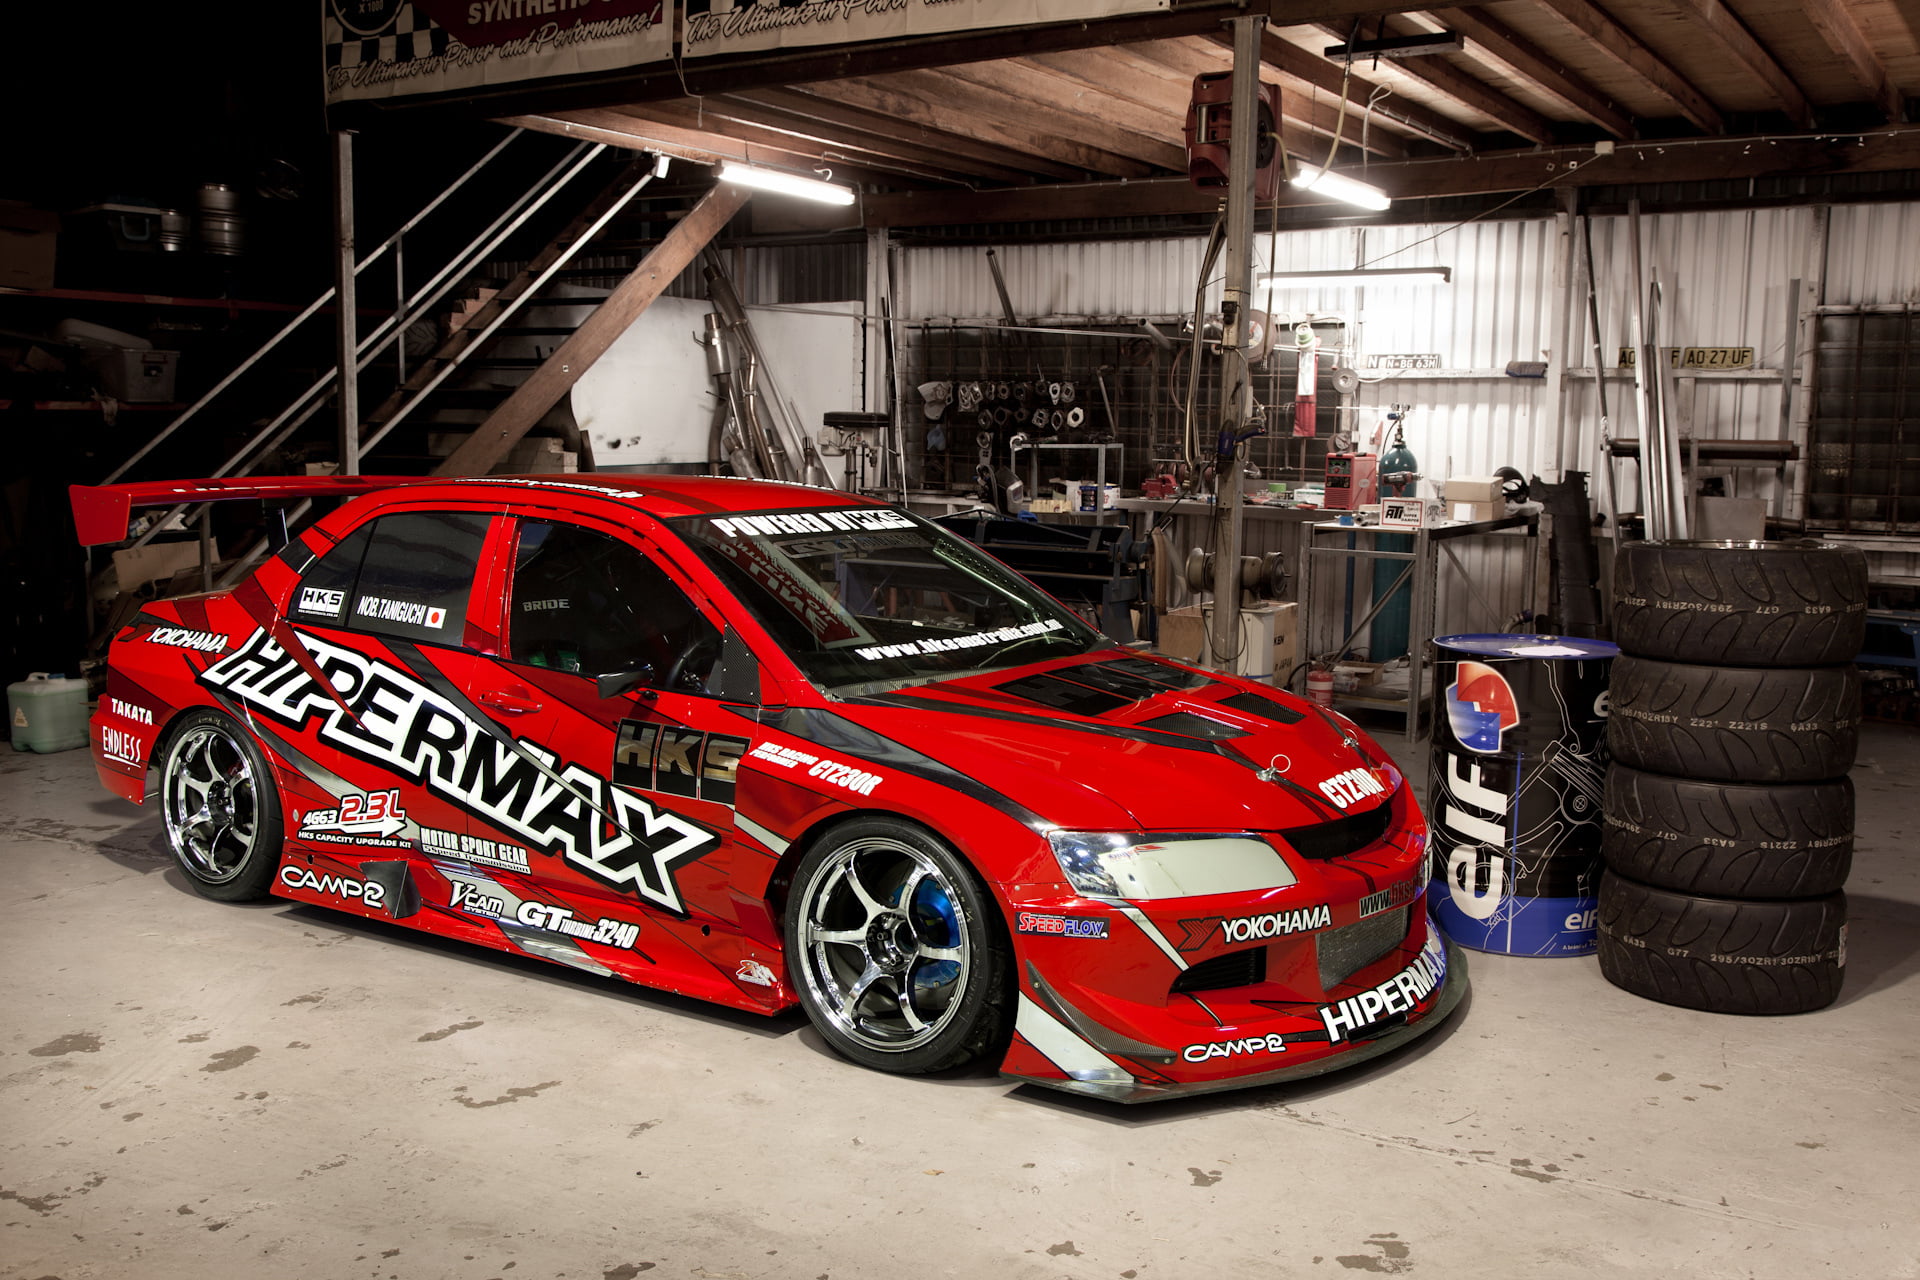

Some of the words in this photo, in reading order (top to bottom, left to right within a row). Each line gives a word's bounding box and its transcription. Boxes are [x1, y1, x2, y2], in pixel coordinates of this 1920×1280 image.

[686, 14, 721, 45] The
[722, 0, 811, 37] Ultimate
[816, 0, 841, 22] in
[327, 64, 350, 94] The
[351, 58, 418, 88] Ultimate
[419, 54, 438, 75] in
[442, 40, 495, 73] Power
[499, 29, 537, 59] and
[535, 2, 662, 54] Performance!
[709, 512, 834, 538] POWERED
[818, 511, 861, 531] BY
[847, 510, 914, 530] HKS
[302, 588, 344, 609] HKS
[355, 595, 427, 625] NOB.TANIGUCHI
[522, 598, 571, 612] BRIDE
[146, 626, 229, 654] YOKOHAMA
[854, 618, 1065, 661] www.hksaustralia.com.au
[111, 698, 153, 727] TAKATA
[102, 725, 142, 763] ENDLESS
[615, 722, 749, 785] HKS
[200, 625, 716, 914] HIPERMAX
[807, 759, 884, 797] CT230R
[1318, 767, 1386, 809] CT230R
[302, 809, 338, 826] 4G63
[339, 789, 407, 826] 2.3L
[297, 831, 315, 840] HKS
[315, 833, 354, 845] CAPACITY
[355, 837, 397, 848] UPGRADE
[399, 840, 413, 849] KIT
[420, 826, 459, 851] MOTOR
[460, 835, 497, 859] SPORT
[498, 843, 529, 866] GEAR
[1445, 752, 1508, 921] elf
[280, 866, 386, 909] CAMP2
[463, 905, 501, 919] SYSTEM
[516, 900, 573, 931] GT
[560, 921, 597, 940] TURBINE
[595, 918, 641, 948] 3240
[1222, 904, 1332, 943] YOKOHAMA
[1564, 908, 1599, 930] elf
[1319, 939, 1446, 1047] HIPERMAX
[1183, 1033, 1287, 1064] CAMP2
